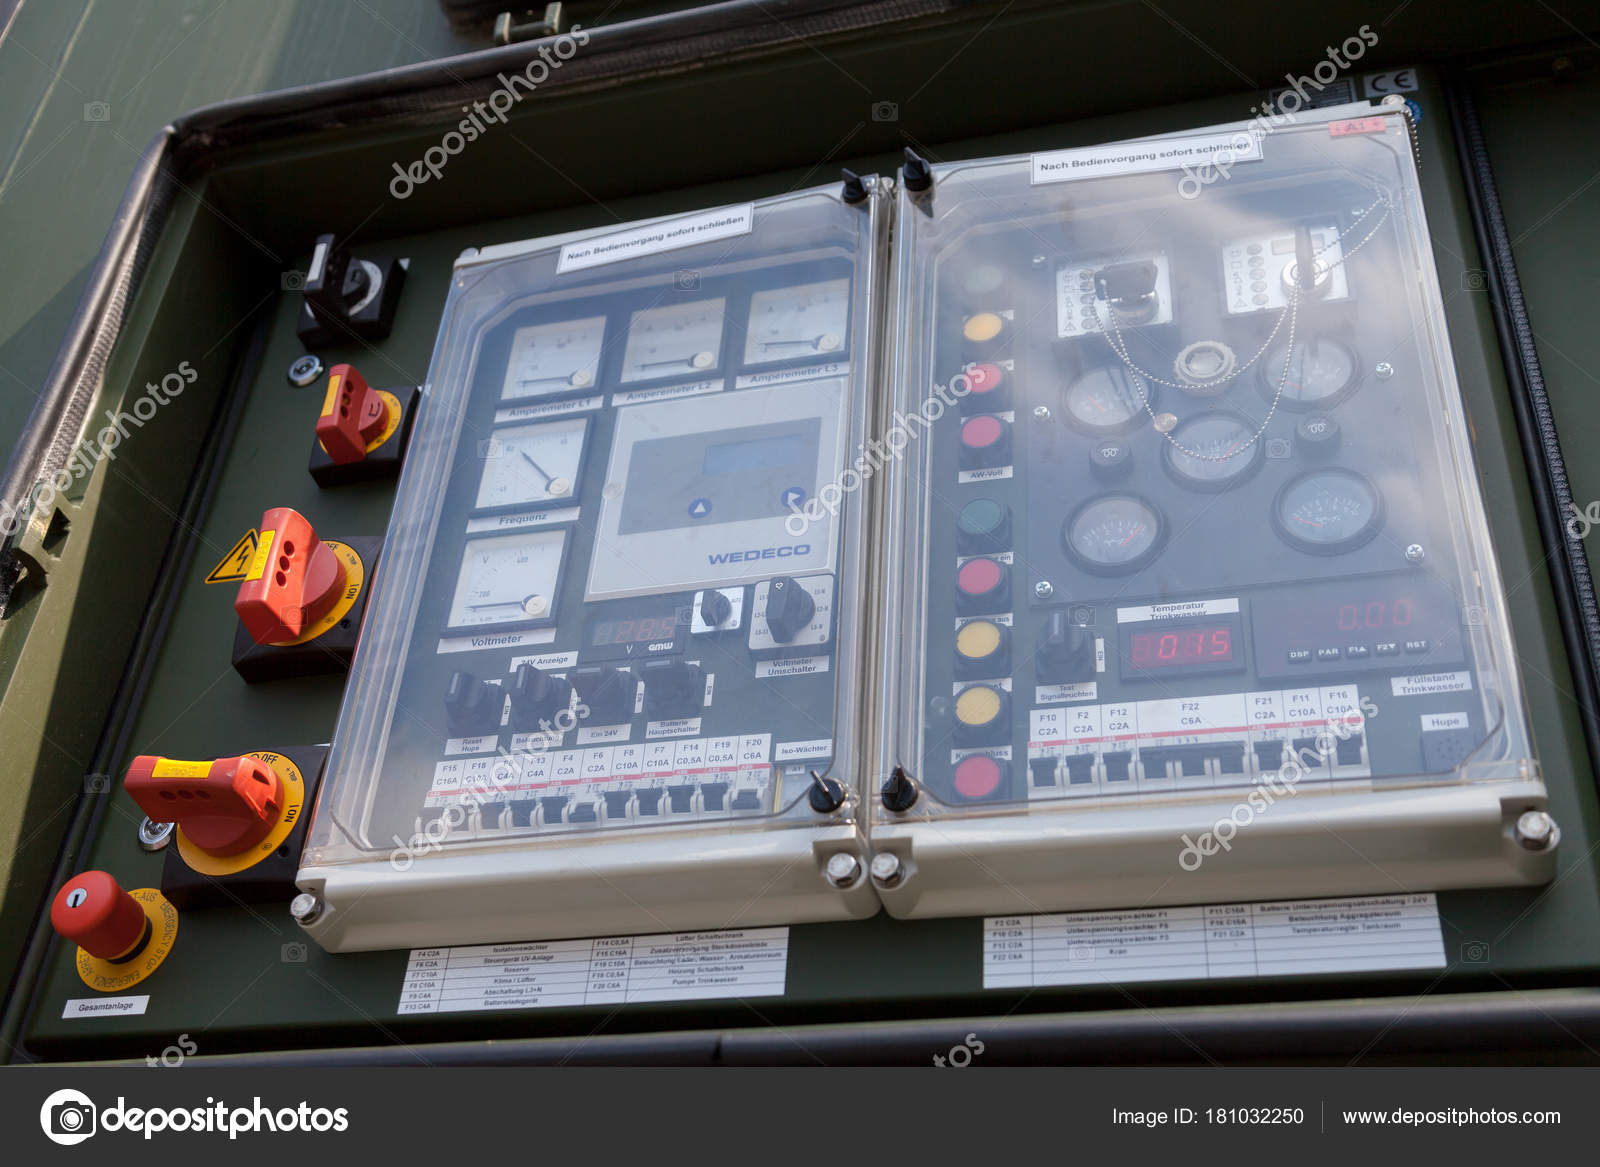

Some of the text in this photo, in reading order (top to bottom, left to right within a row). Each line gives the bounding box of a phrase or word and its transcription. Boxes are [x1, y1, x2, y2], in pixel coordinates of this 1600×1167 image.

[1371, 71, 1412, 92] CE
[1040, 161, 1069, 171] Nach
[1072, 152, 1156, 168] Bedienvorgang
[1159, 148, 1193, 158] sofort
[567, 215, 744, 260] Nach Bedienvorgang sofort schließen
[750, 367, 822, 383] Amperemeter
[627, 384, 696, 401] Amperemeter
[509, 402, 576, 417] Amperemeter
[499, 513, 548, 526] Frequenz
[708, 544, 811, 565] WEDECO
[1151, 602, 1206, 613] Temperatur
[471, 635, 523, 647] Voltmeter
[537, 656, 568, 666] Anzeige
[773, 657, 813, 668] Voltmeter
[768, 664, 817, 676] Umschalter
[1401, 682, 1465, 694] Trinkwasser
[1255, 697, 1273, 705] F21
[1292, 694, 1310, 703] F11
[1181, 702, 1200, 711] F22
[1077, 711, 1089, 719] F2
[1110, 708, 1128, 717] F12
[1254, 711, 1276, 720] C2A
[1289, 708, 1317, 717] C10A
[1039, 714, 1057, 722] F10
[1431, 717, 1460, 727] Hupe
[648, 726, 700, 736] Hauptschalter
[1073, 725, 1094, 734] C2A
[1109, 722, 1130, 731] C2A
[604, 729, 618, 737] 24V
[1038, 728, 1058, 736] C2A
[745, 738, 762, 747] F20
[654, 746, 665, 754] F7
[683, 743, 699, 752] F14
[781, 744, 828, 756] Iso-Wächter
[562, 753, 574, 762] F4
[743, 751, 762, 760] C6A
[615, 760, 639, 770] C10A
[646, 758, 669, 768] C10A
[557, 767, 575, 776] C2A
[587, 764, 605, 773] C2A
[527, 769, 545, 778] C4A
[78, 1002, 134, 1012] Gesamtanlage
